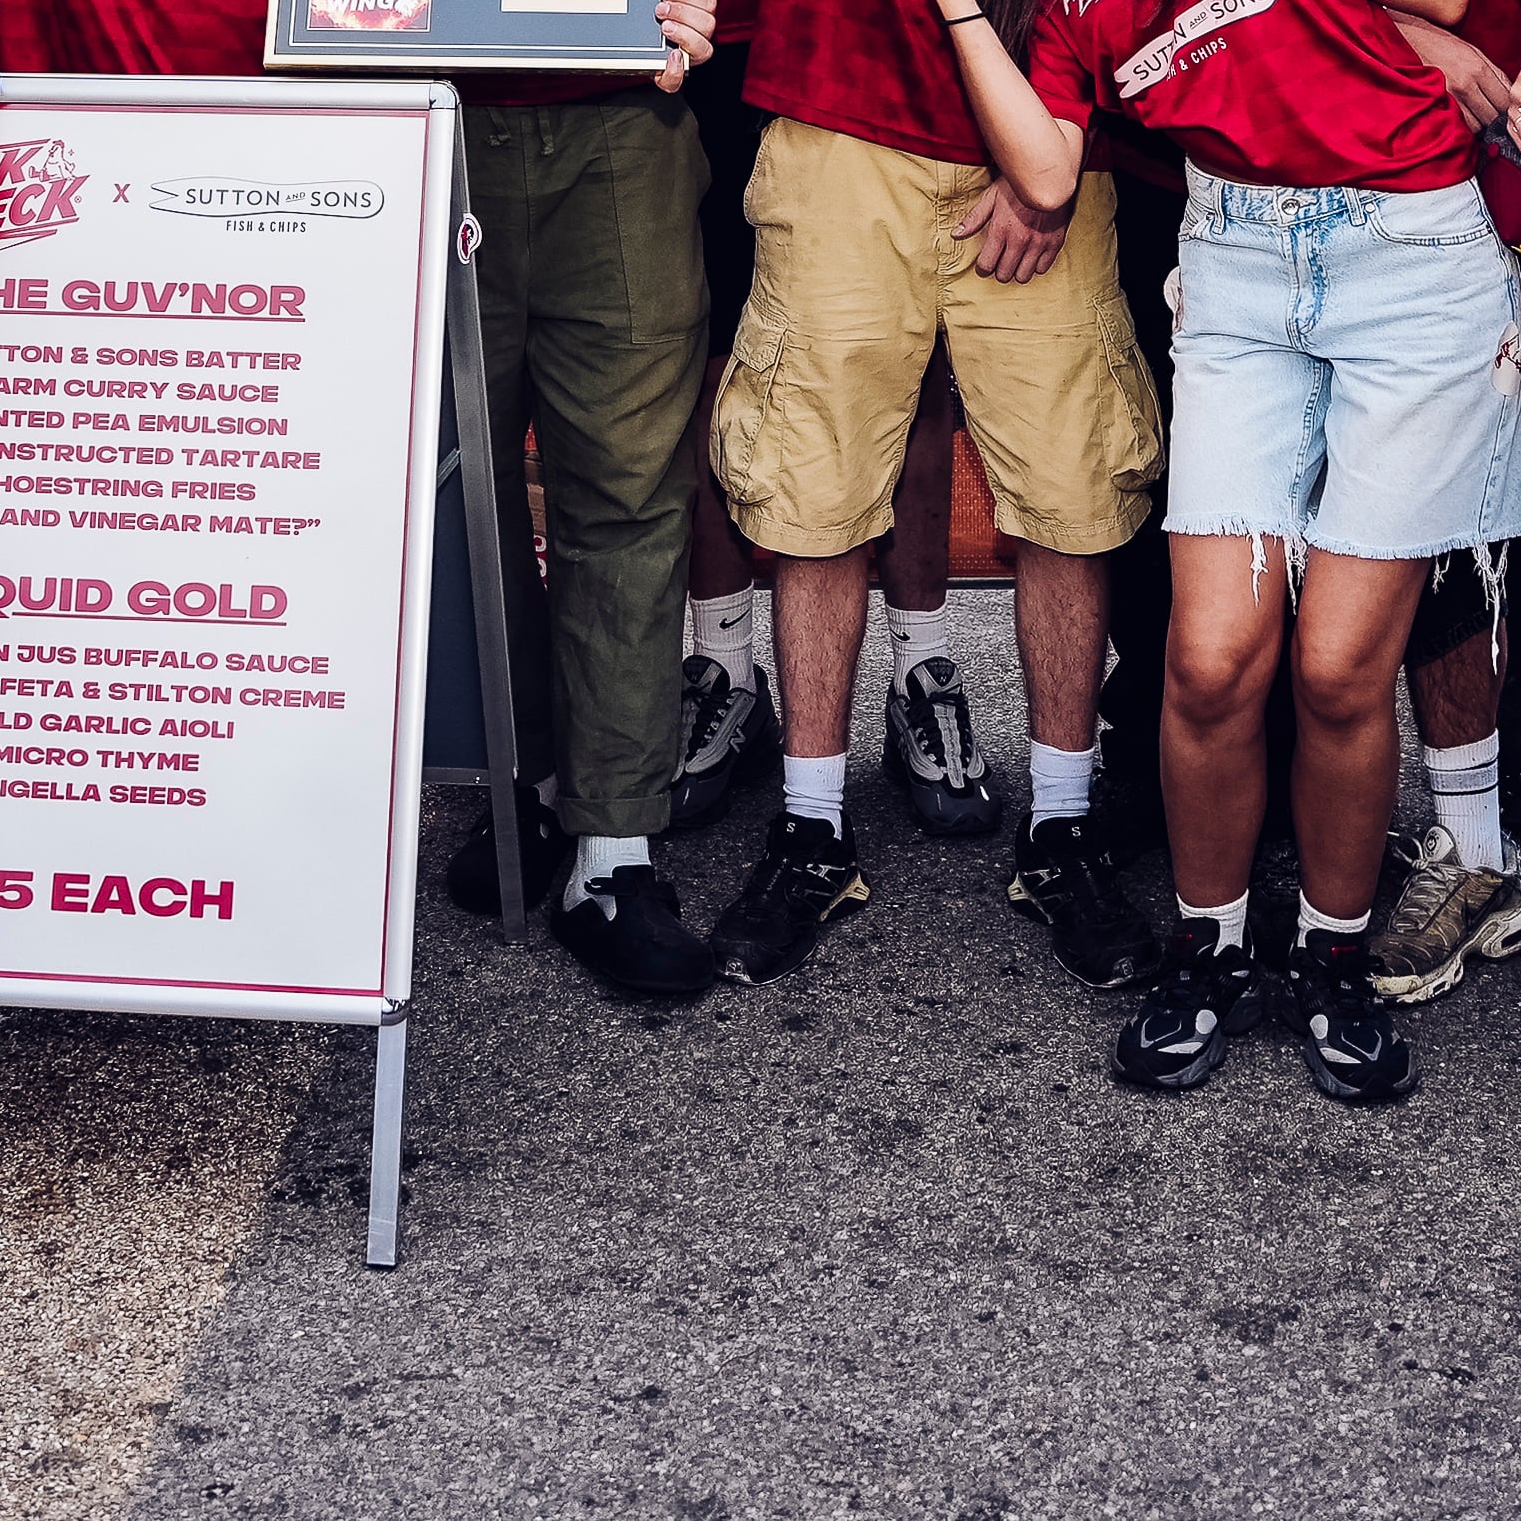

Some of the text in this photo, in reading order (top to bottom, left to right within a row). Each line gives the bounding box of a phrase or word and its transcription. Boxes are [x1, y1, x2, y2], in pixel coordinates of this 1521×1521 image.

[1189, 11, 1207, 29] AND
[1179, 37, 1227, 71] & CHIPS
[186, 188, 372, 209] SUTTON AND SONS
[226, 220, 307, 234] FISH & CHIPS
[71, 347, 88, 364] &
[96, 348, 178, 367] SONS
[186, 351, 301, 370] BATTER
[64, 380, 169, 399] CURRY
[177, 383, 278, 402] SAUCE
[72, 412, 130, 431] PEA
[138, 415, 287, 435] EMULSION
[182, 449, 320, 469] TARTARE
[172, 481, 255, 501] FRIES
[0, 509, 60, 527] AND
[69, 511, 201, 532] VINEGAR
[127, 581, 287, 619] GOLD
[17, 645, 76, 664] JUS
[84, 648, 218, 669] BUFFALO
[226, 654, 329, 674] SAUCE
[0, 678, 74, 698] FETA
[82, 682, 100, 699] &
[108, 683, 231, 704] STILTON
[240, 688, 345, 709] CREME
[40, 714, 151, 735] GARLIC
[159, 719, 234, 739] AIOLI
[96, 750, 199, 771] THYME
[109, 785, 206, 806] SEEDS
[51, 873, 234, 920] EACH
